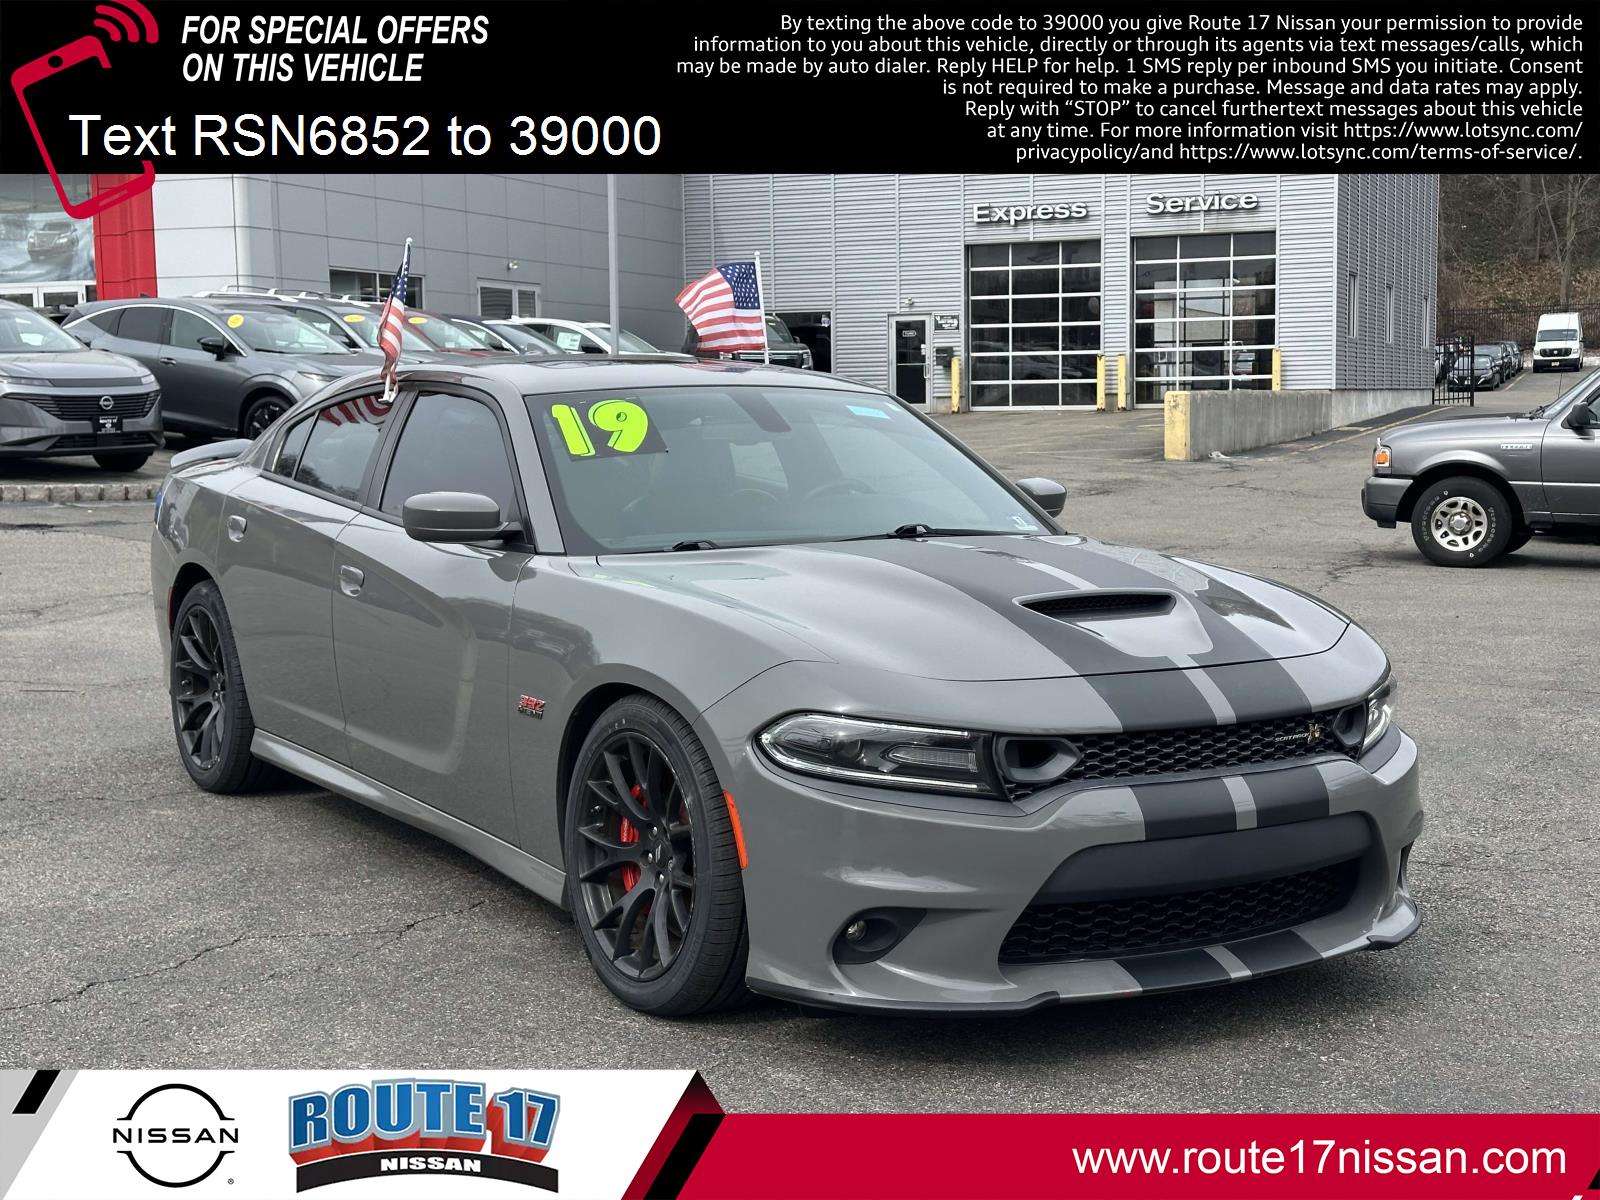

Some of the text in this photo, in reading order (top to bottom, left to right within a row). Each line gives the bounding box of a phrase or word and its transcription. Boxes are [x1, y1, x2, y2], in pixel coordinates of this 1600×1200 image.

[973, 201, 1088, 226] Express
[1146, 189, 1259, 215] Service
[551, 399, 648, 457] 19
